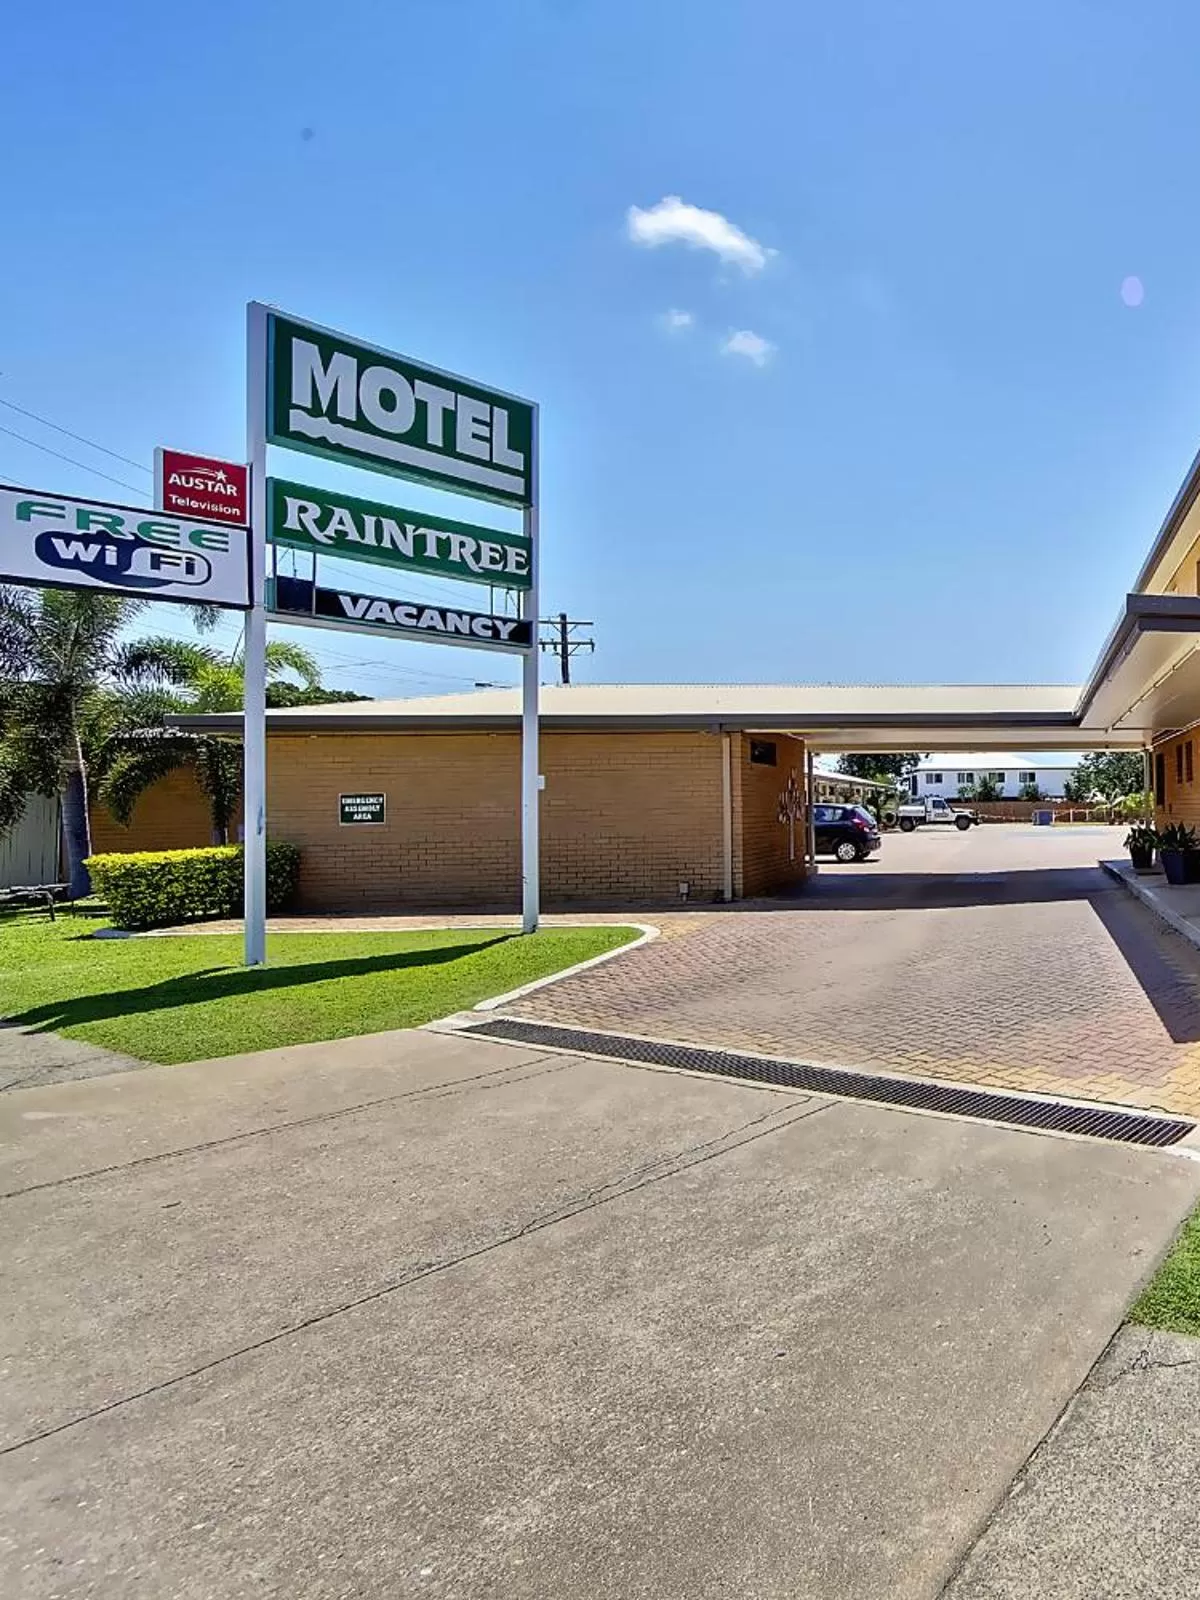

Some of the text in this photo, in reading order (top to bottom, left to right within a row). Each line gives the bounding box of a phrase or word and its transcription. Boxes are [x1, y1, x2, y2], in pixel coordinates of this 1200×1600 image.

[291, 336, 524, 471] MOTEL
[168, 472, 238, 497] AUSTAR
[168, 493, 241, 517] Television
[16, 500, 229, 553] FREE
[283, 495, 530, 575] RAINTREE
[338, 594, 519, 640] VACANCY
